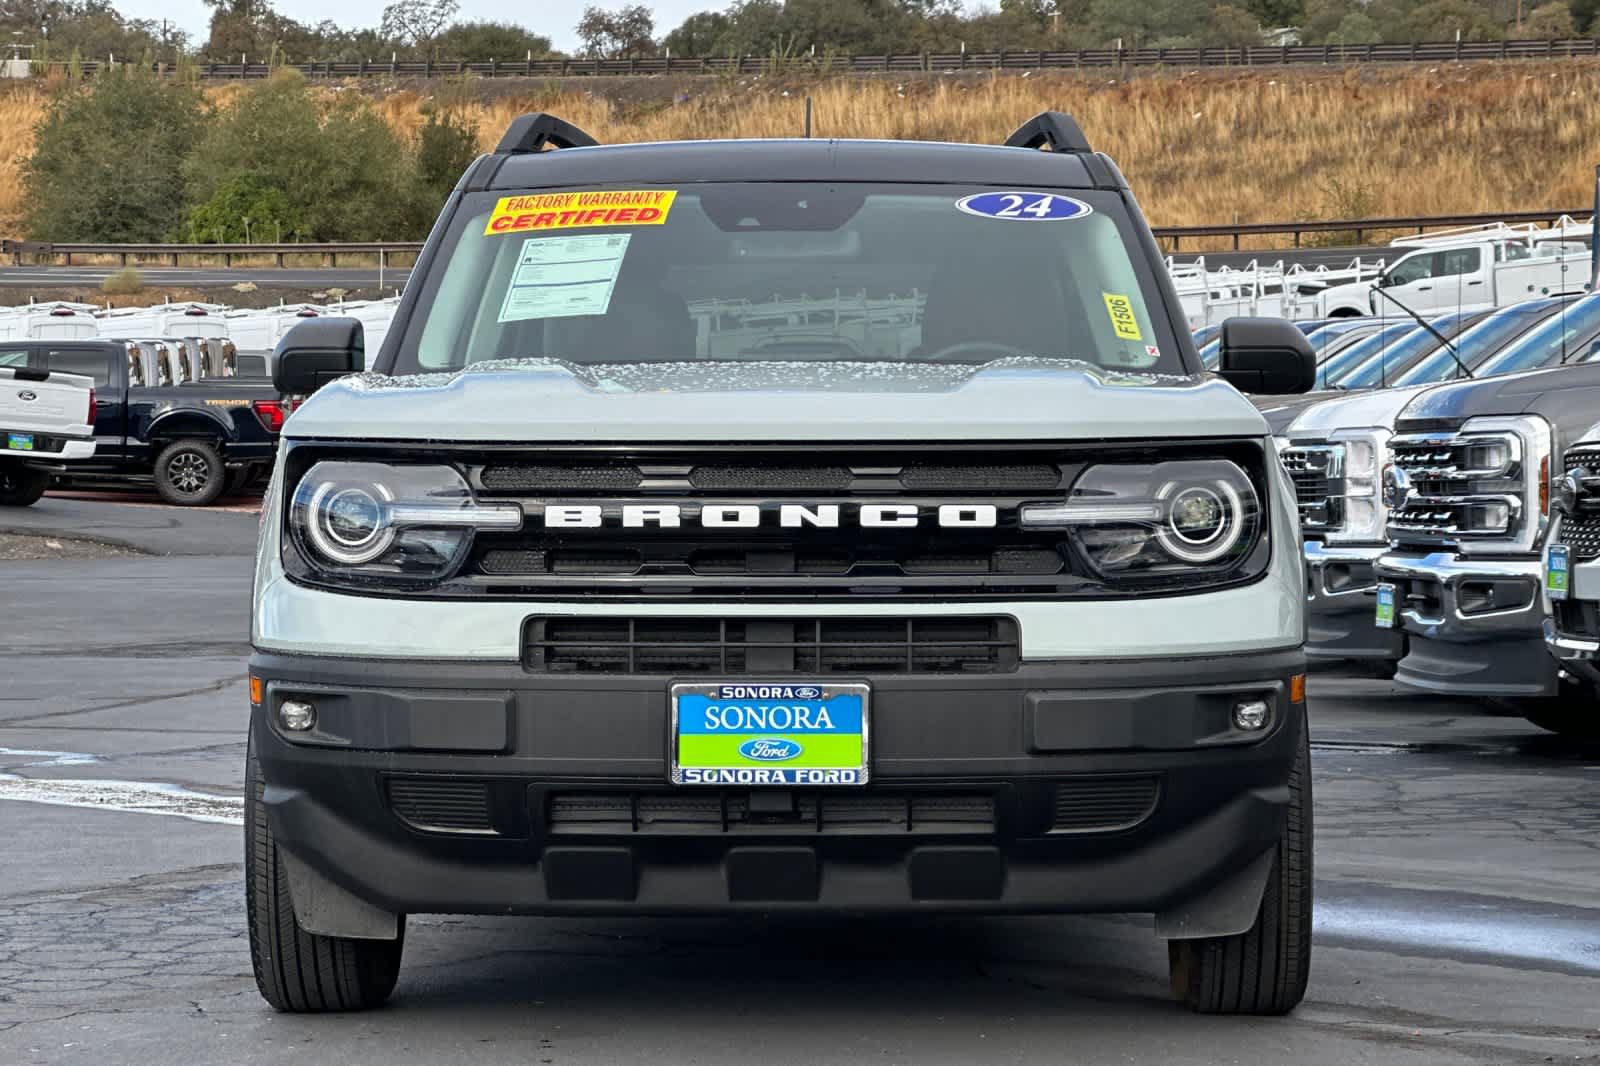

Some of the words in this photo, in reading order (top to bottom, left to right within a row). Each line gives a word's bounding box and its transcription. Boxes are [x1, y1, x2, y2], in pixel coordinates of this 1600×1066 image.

[506, 193, 576, 212] FACTORY
[578, 191, 666, 207] WARRANTY
[995, 194, 1053, 217] 24
[491, 207, 661, 232] CERTIFIED
[1108, 297, 1137, 335] F1506
[544, 504, 998, 528] BRONCO
[721, 686, 794, 699] SONORA
[704, 705, 836, 730] SONORA
[750, 740, 790, 758] Ford
[685, 769, 787, 784] SONORA
[795, 769, 856, 784] FORD
